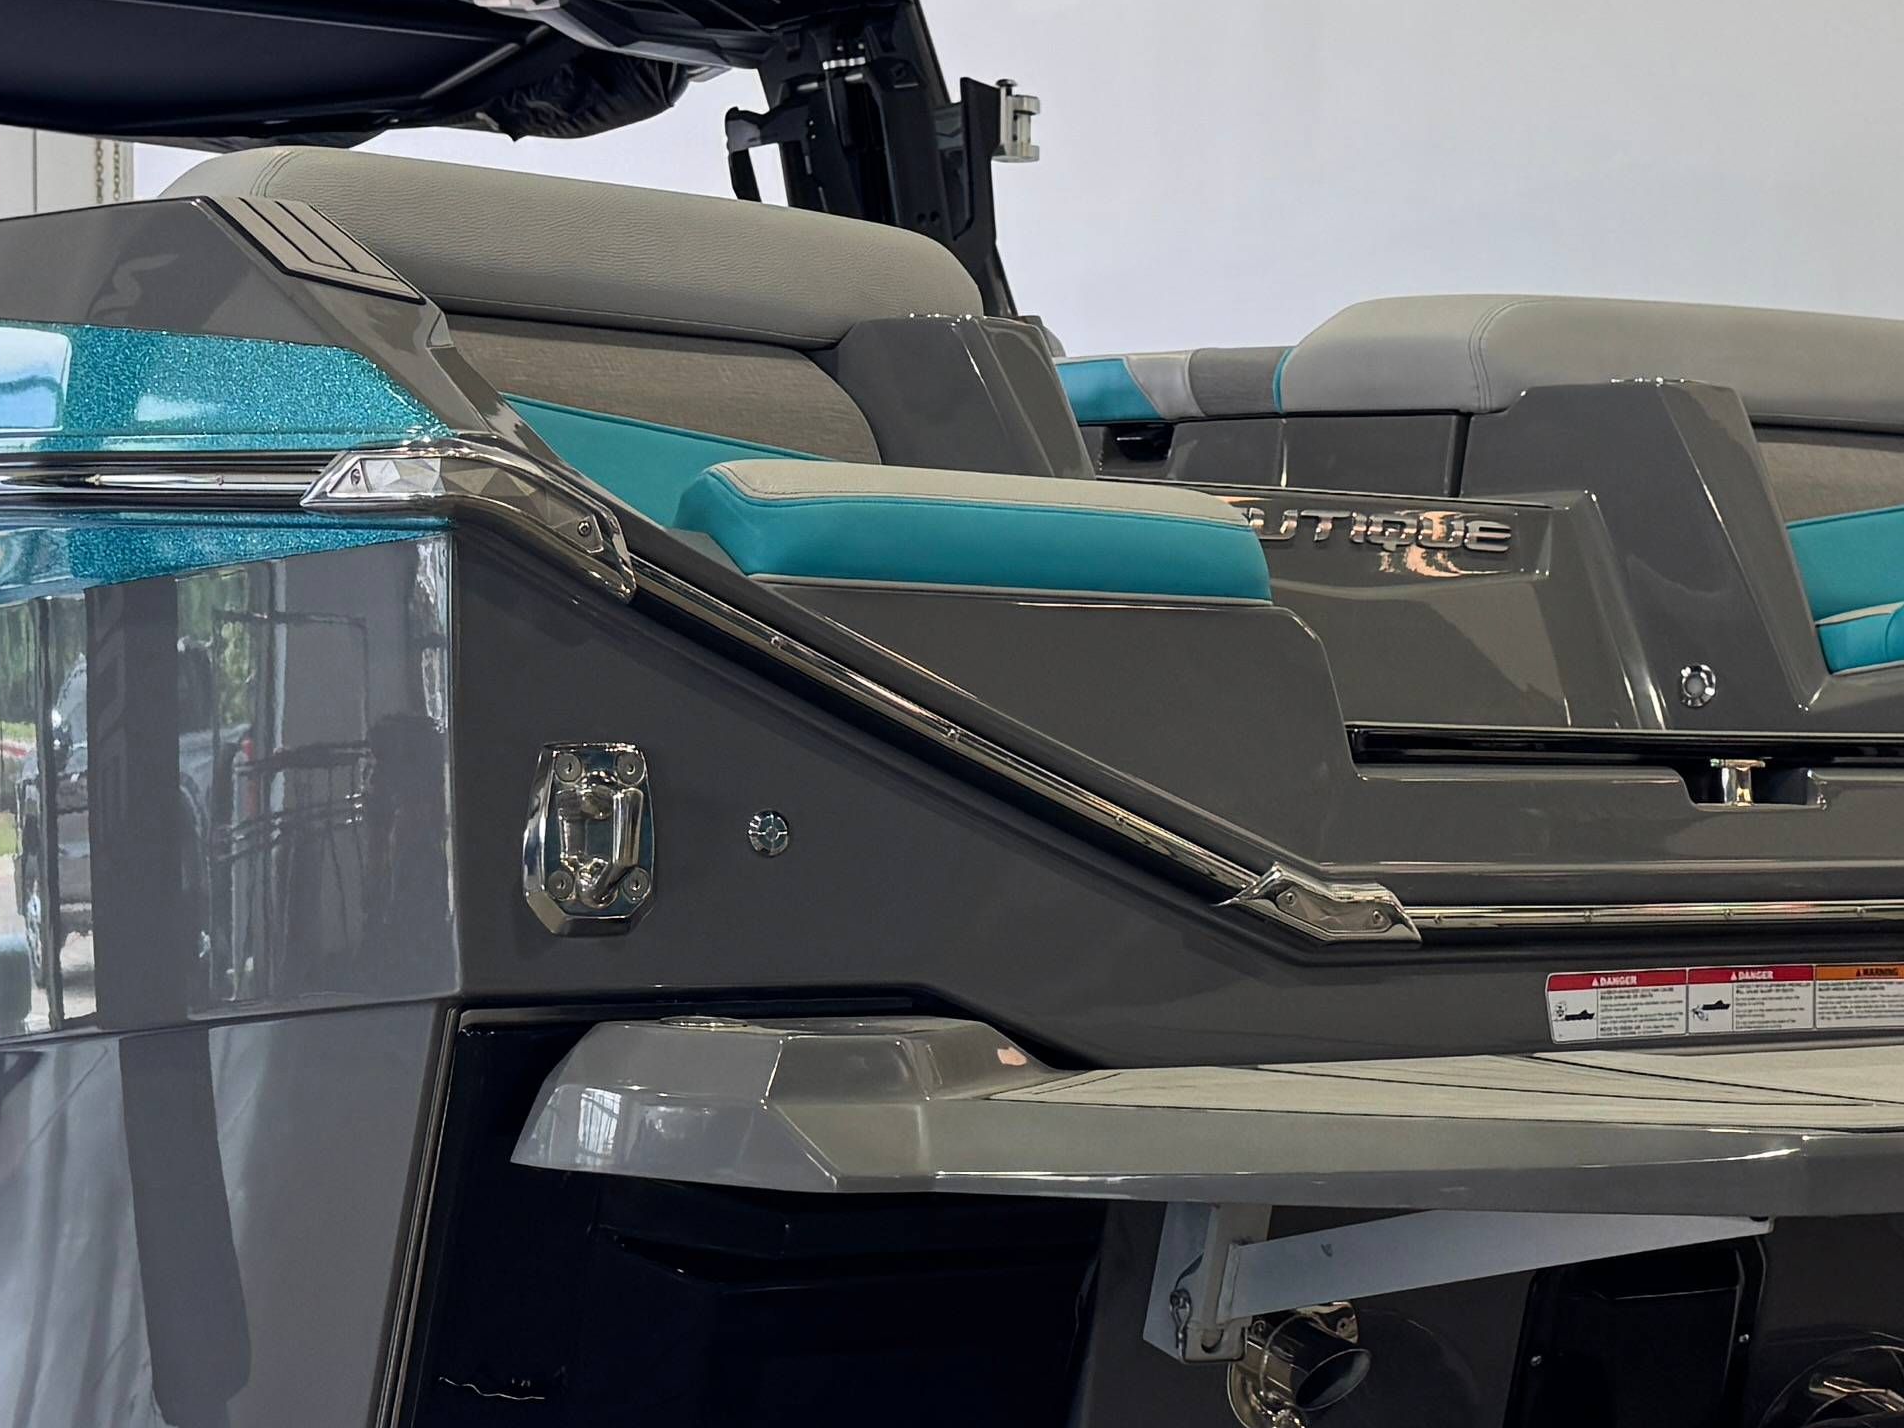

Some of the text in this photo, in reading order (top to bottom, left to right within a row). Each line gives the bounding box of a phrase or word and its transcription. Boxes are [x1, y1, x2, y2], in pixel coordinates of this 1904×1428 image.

[1246, 506, 1512, 553] UTIQUE
[1599, 975, 1637, 987] DANGER
[1738, 970, 1774, 981] DANGER
